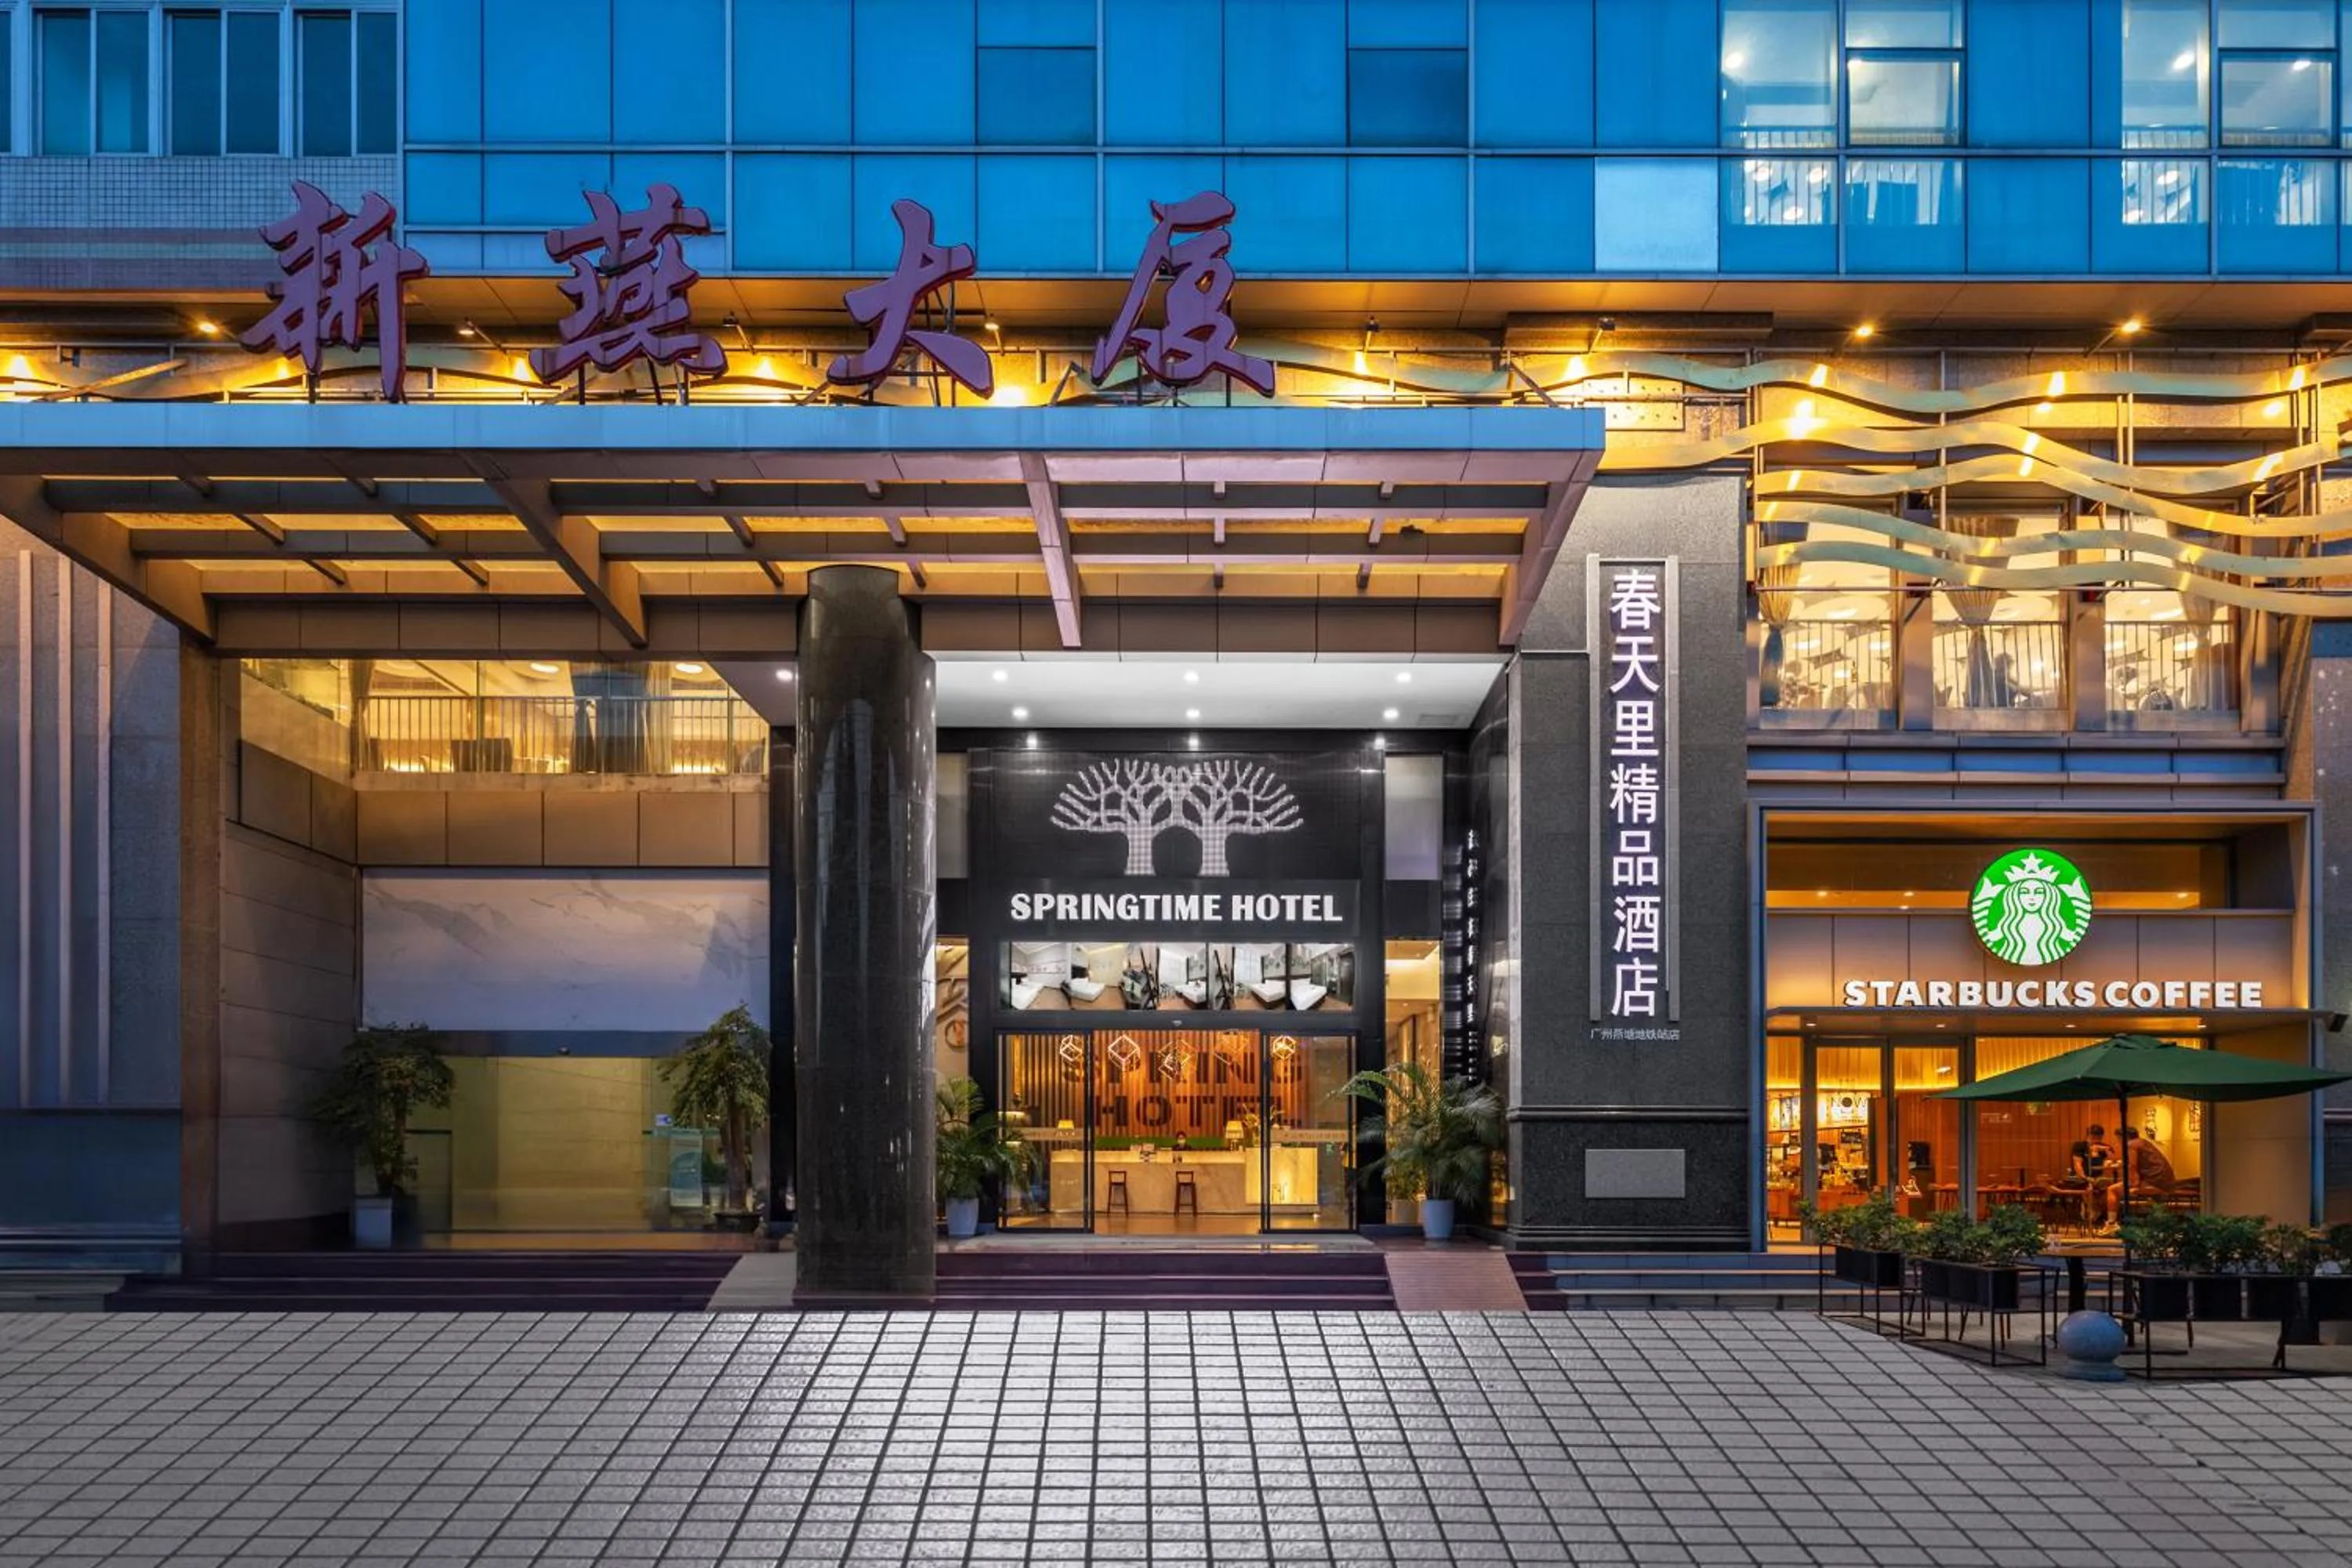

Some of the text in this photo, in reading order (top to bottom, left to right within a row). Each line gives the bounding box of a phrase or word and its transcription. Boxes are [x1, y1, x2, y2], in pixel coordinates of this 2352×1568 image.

[1610, 568, 1661, 1017] 春天里精品酒店
[1011, 893, 1343, 921] SPRINGTIME HOTEL
[1843, 980, 2263, 1008] STARBUCKS COFFEE
